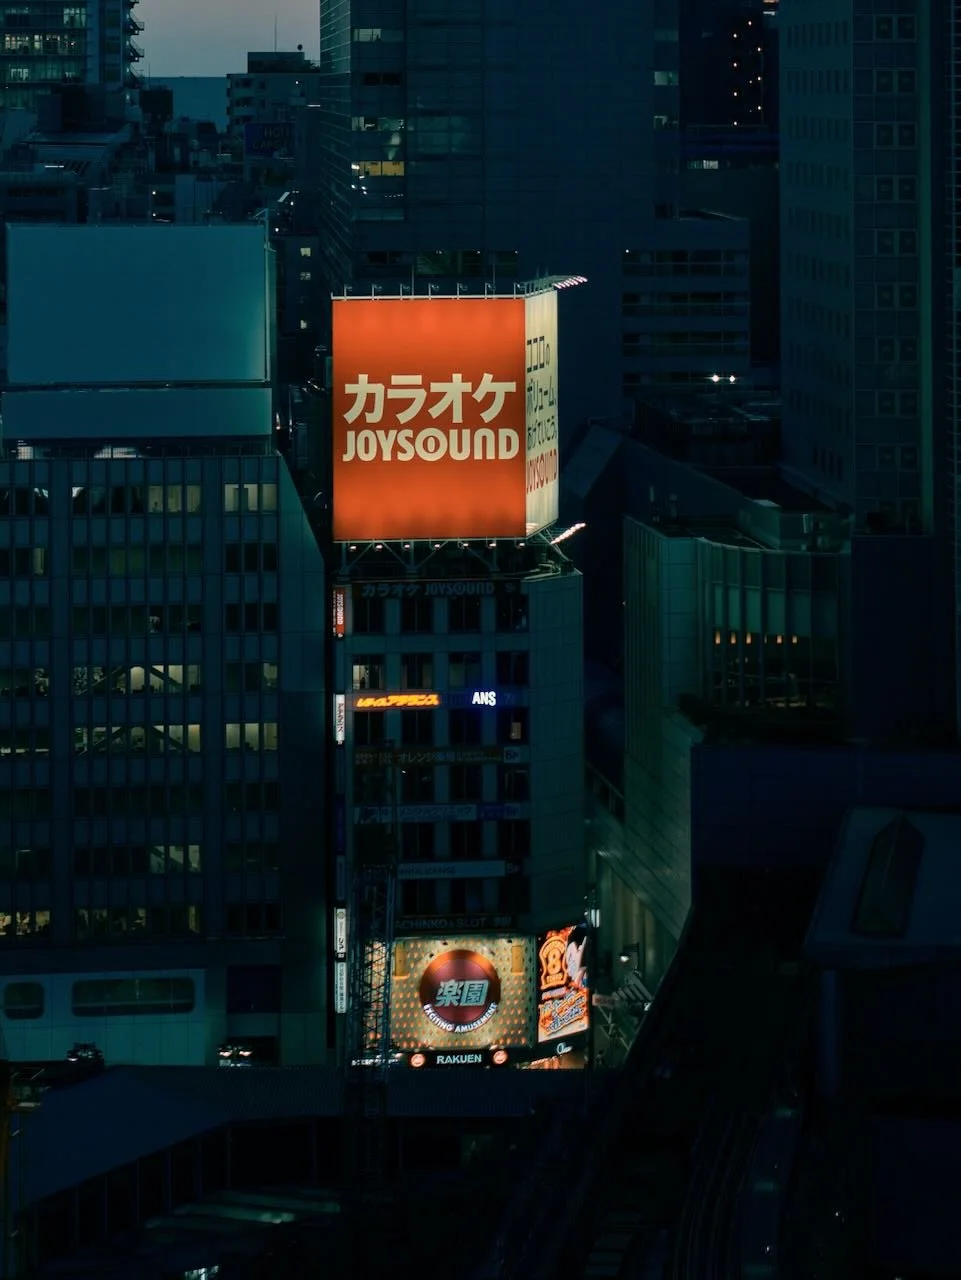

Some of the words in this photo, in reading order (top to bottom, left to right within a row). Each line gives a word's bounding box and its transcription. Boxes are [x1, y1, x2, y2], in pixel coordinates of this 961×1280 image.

[342, 372, 517, 425] カラオケ
[342, 426, 520, 462] JOYSOUND
[526, 447, 557, 495] JOYSOUND
[361, 582, 421, 597] カラオケ
[423, 580, 497, 596] JOYSOUND
[471, 690, 497, 706] ANS
[435, 979, 490, 1007] 楽園
[423, 1003, 455, 1032] EXCITING
[454, 1001, 498, 1033] AMUSEMENT
[436, 1054, 483, 1065] RAKUEN
